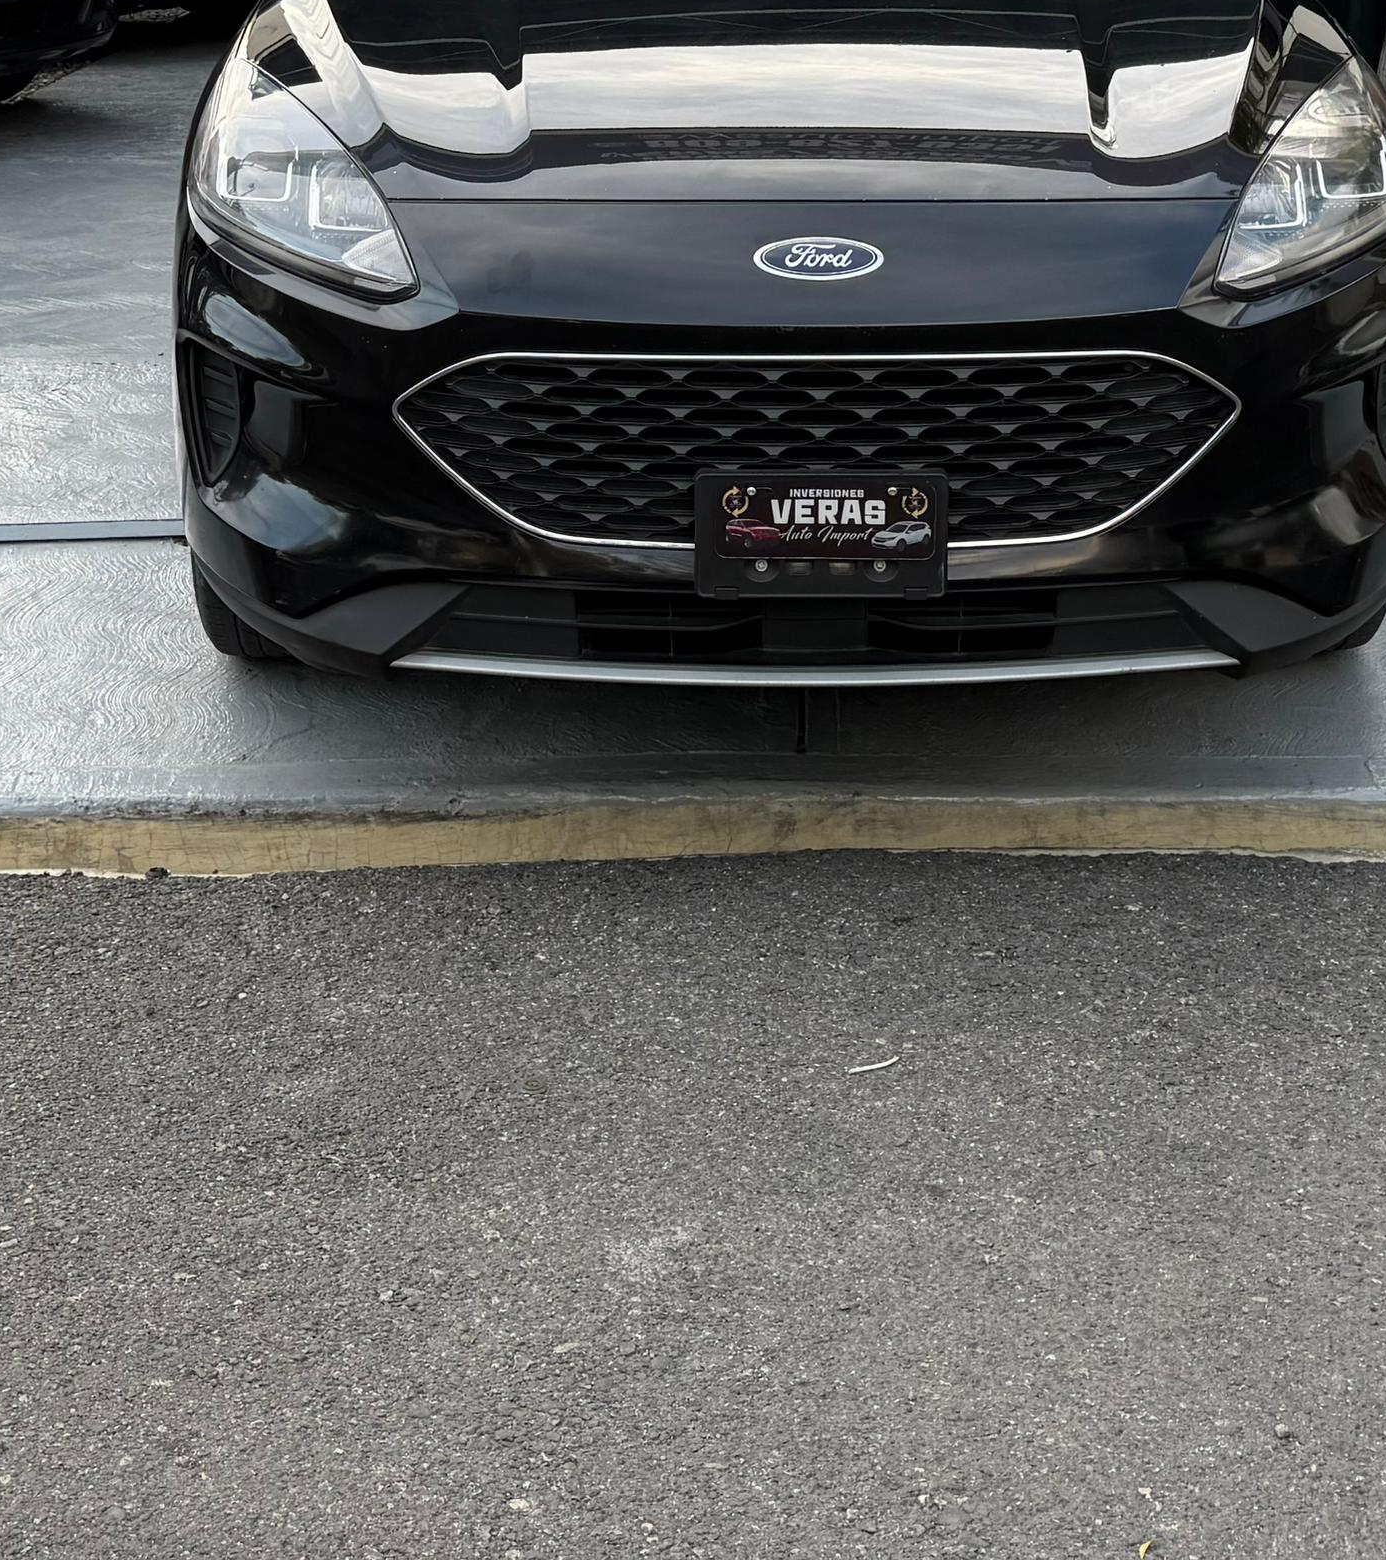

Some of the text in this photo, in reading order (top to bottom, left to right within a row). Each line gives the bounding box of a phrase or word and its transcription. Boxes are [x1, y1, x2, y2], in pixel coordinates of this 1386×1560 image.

[784, 243, 854, 268] Ford
[789, 488, 865, 498] INVERSIONES
[770, 499, 886, 525] VERAS
[779, 524, 876, 547] Auto Import
